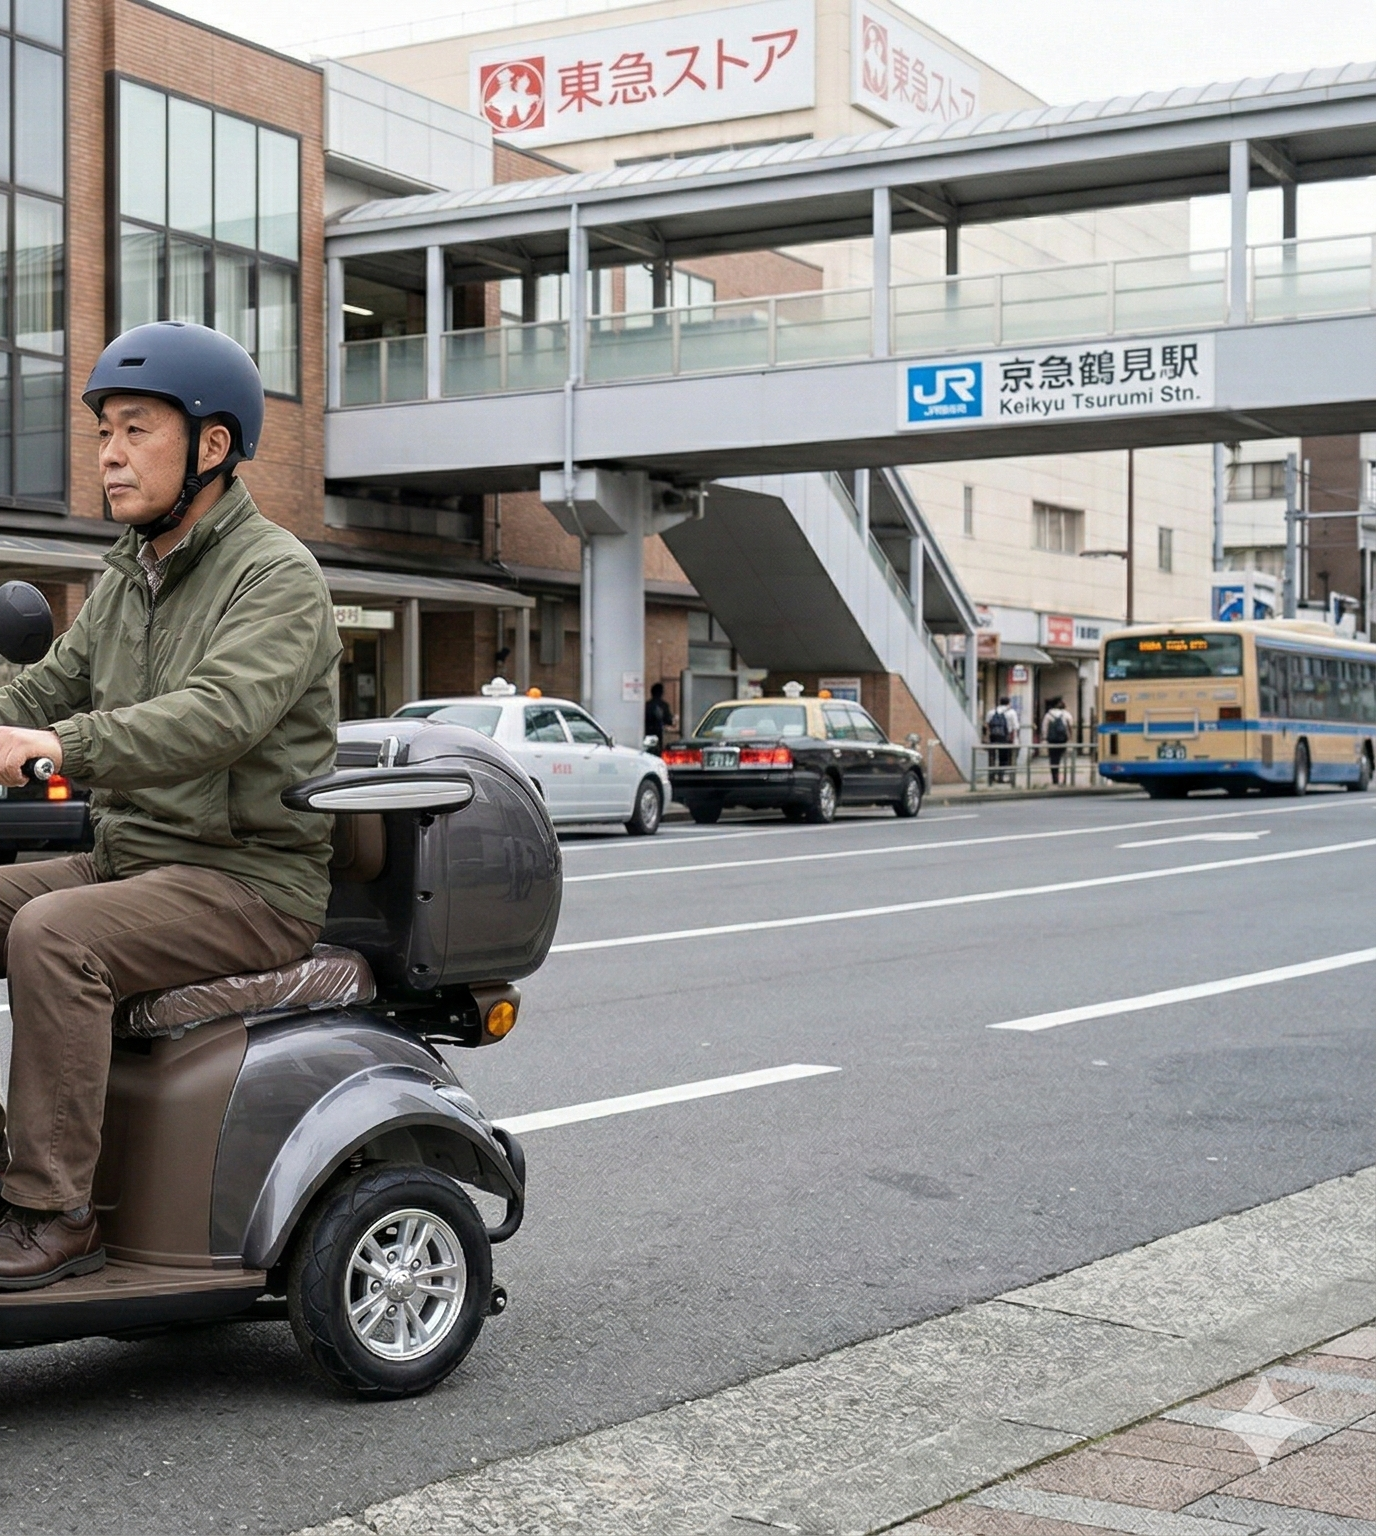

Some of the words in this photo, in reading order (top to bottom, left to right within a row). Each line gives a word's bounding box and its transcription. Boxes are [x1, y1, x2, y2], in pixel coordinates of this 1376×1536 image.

[557, 28, 799, 113] 東急ストア
[891, 47, 976, 121] 東急ストア
[913, 368, 975, 405] JR
[999, 343, 1199, 393] 京急鶴見駅
[1000, 396, 1065, 417] Keikyu
[1072, 387, 1153, 409] Tsurumi
[1161, 386, 1201, 402] Stn.
